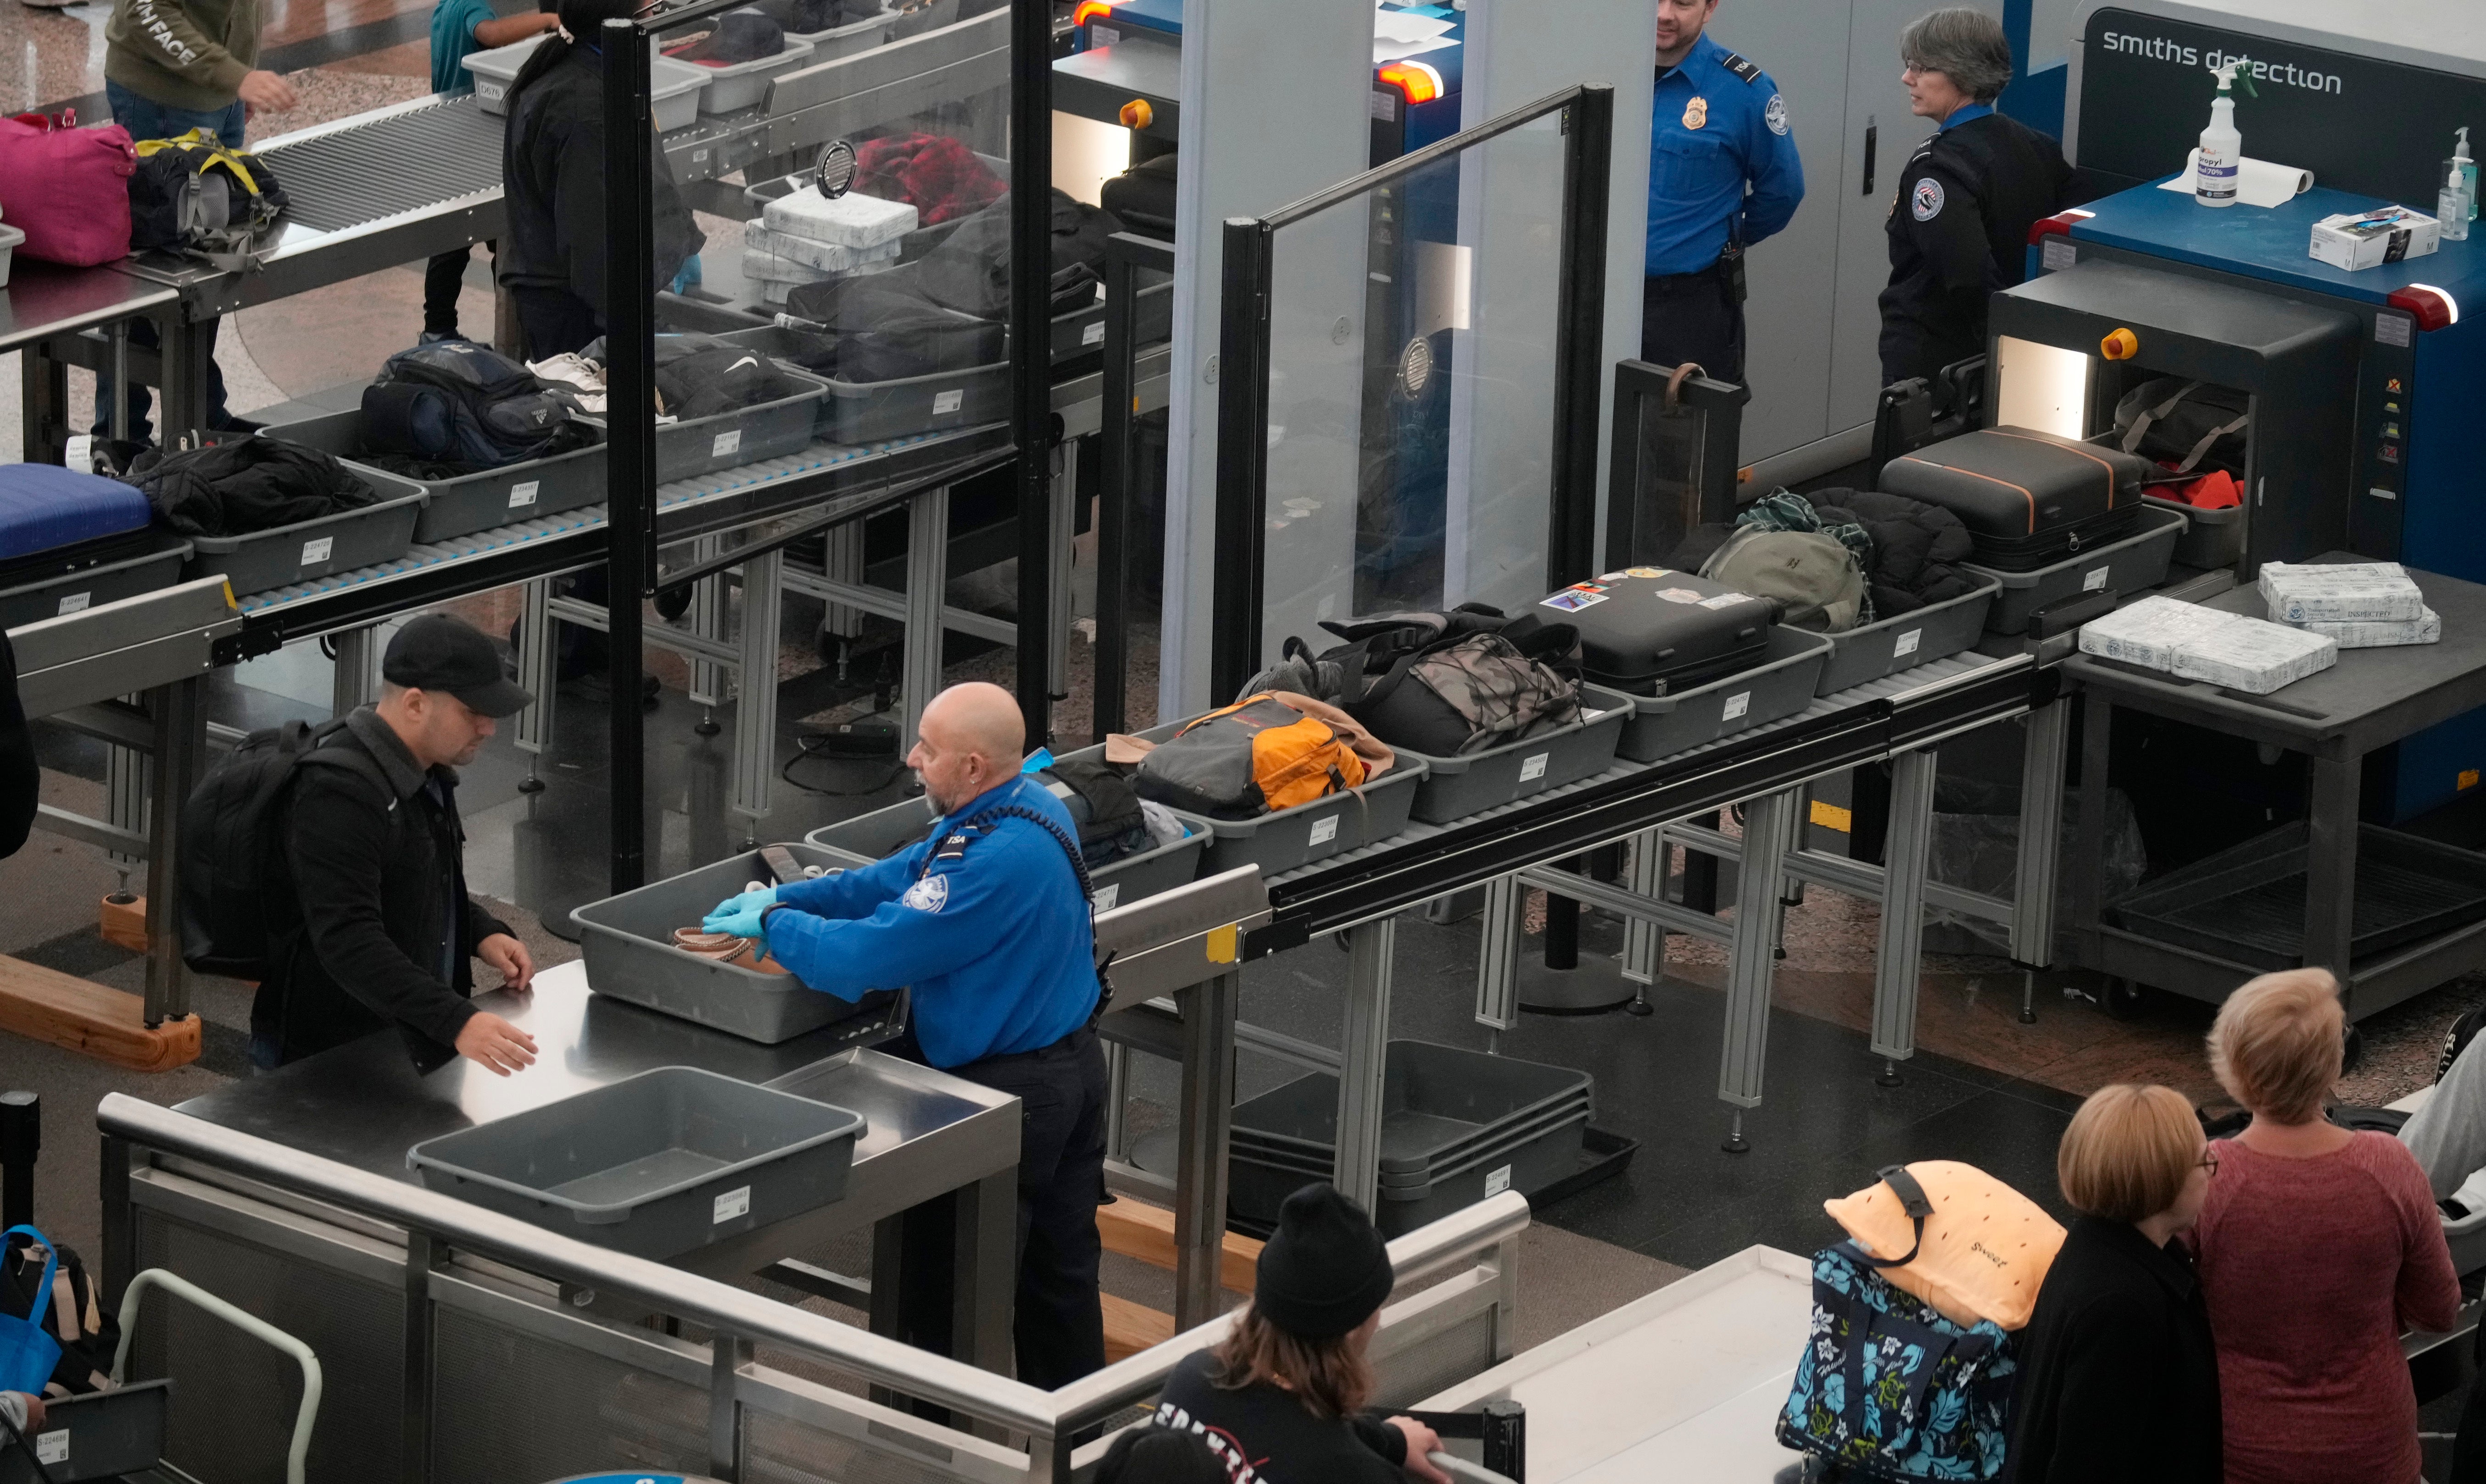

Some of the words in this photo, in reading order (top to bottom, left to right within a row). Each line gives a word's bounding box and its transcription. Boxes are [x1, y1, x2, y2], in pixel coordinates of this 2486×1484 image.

[148, 20, 196, 65] FACE
[2103, 32, 2197, 66] smiths
[1734, 61, 1751, 72] TSA
[2426, 242, 2434, 250] M
[947, 835, 966, 845] TSA
[1971, 1242, 2008, 1268] Sweet
